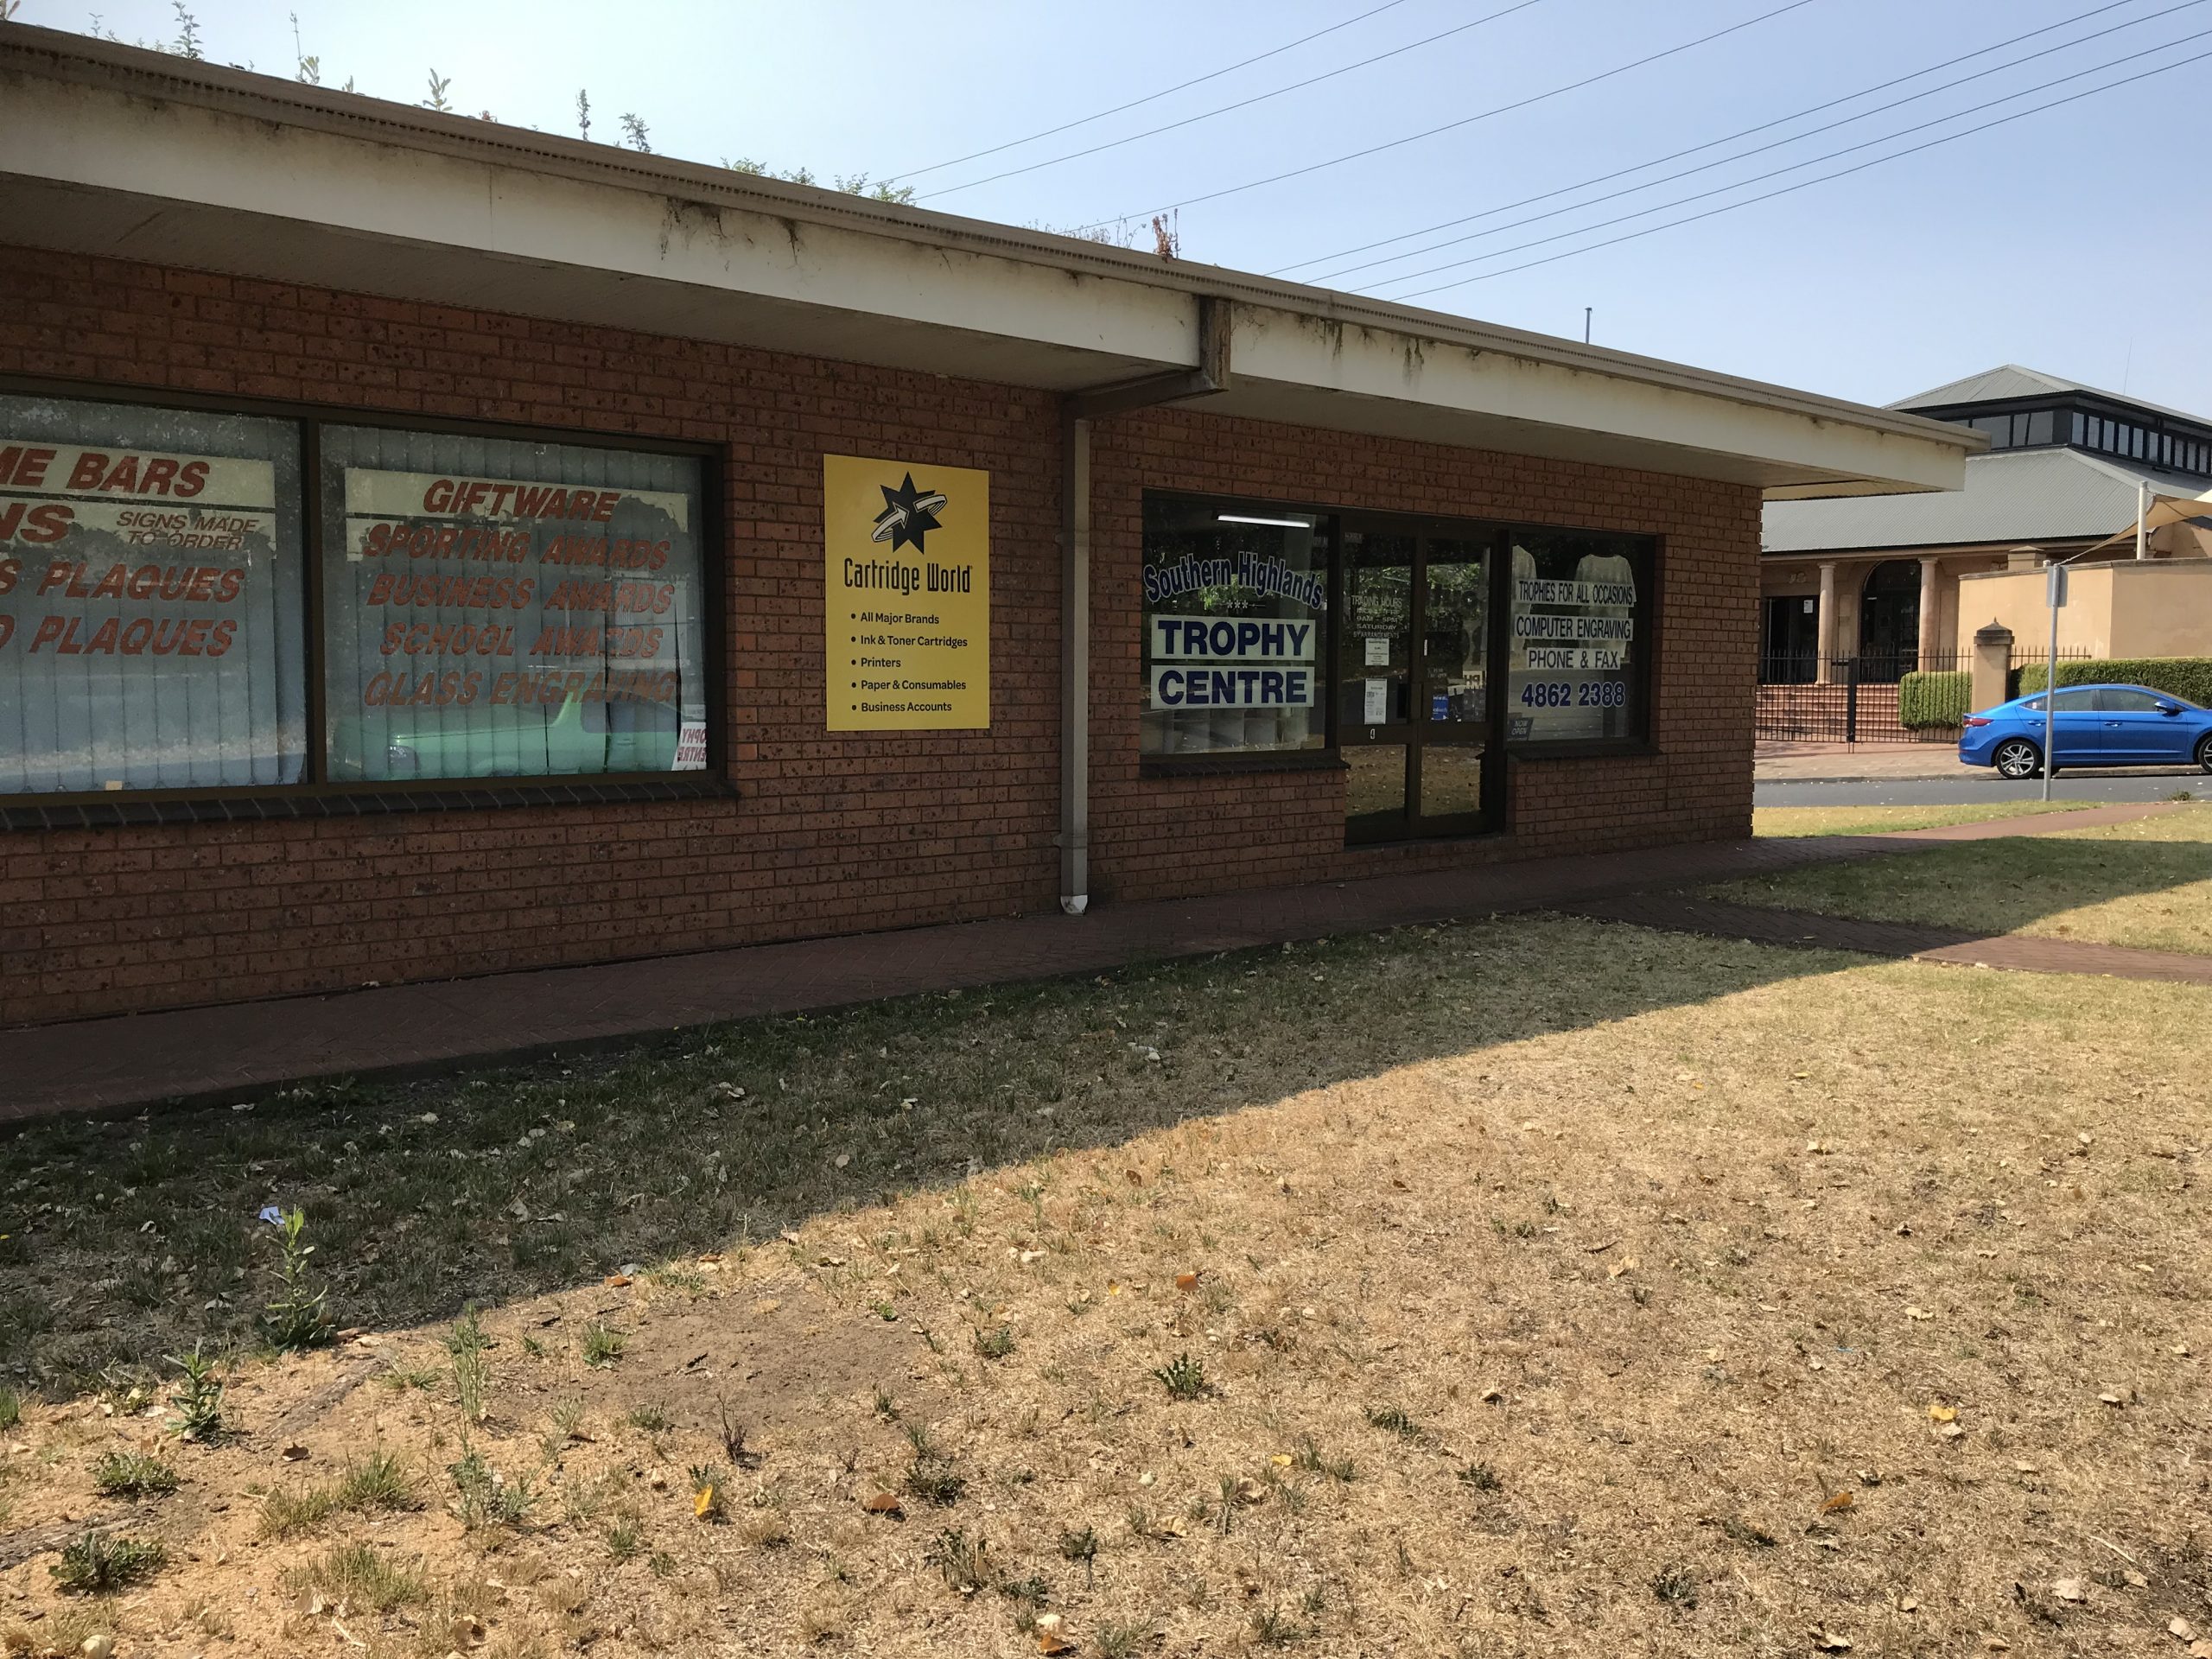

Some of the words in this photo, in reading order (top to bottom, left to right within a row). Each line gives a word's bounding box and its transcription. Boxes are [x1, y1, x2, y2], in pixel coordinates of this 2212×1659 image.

[67, 452, 210, 498] BARS
[423, 480, 621, 522] GIFTWARE
[117, 512, 188, 530] SIGNS
[194, 517, 259, 533] MADE
[129, 531, 156, 545] TO
[168, 531, 243, 550] ORDER
[363, 524, 531, 563] SPORTING
[540, 536, 671, 570] AWARDS
[36, 561, 245, 602] PLAQUES
[366, 573, 535, 609] BUSINESS
[543, 580, 676, 614] AWARDS
[844, 558, 920, 595] Cartridge
[927, 563, 970, 593] World
[1143, 552, 1232, 602] Southern
[1237, 550, 1325, 609] Highlands
[1519, 581, 1555, 602] TROPHIES
[1558, 582, 1573, 602] FOR
[1576, 583, 1590, 603] ALL
[1593, 584, 1633, 605] OCCASIONS
[861, 612, 874, 622] All
[875, 613, 903, 625] Major
[905, 613, 939, 624] Brands
[1516, 617, 1573, 638] COMPUTER
[1578, 619, 1631, 639] ENGRAVING
[29, 615, 238, 657] PLAQUES
[380, 622, 515, 656] SCHOOL
[530, 628, 663, 658] AWARDS
[861, 635, 876, 645] Ink
[878, 635, 886, 645] &
[887, 635, 916, 645] Toner
[918, 636, 968, 649] Cartridges
[1158, 620, 1309, 656] TROPHY
[861, 657, 901, 667] Printers
[1529, 650, 1573, 669] PHONE
[1580, 651, 1588, 668] &
[1595, 651, 1618, 669] FAX
[365, 671, 482, 706] GLASS
[489, 671, 677, 705] ENGRAVING
[861, 680, 891, 691] Paper
[893, 680, 900, 690] &
[902, 680, 966, 690] Consumables
[1159, 671, 1307, 705] CENTRE
[1521, 683, 1572, 708] 4862
[1578, 682, 1626, 708] 2388
[861, 702, 905, 712] Business
[907, 702, 952, 711] Accounts
